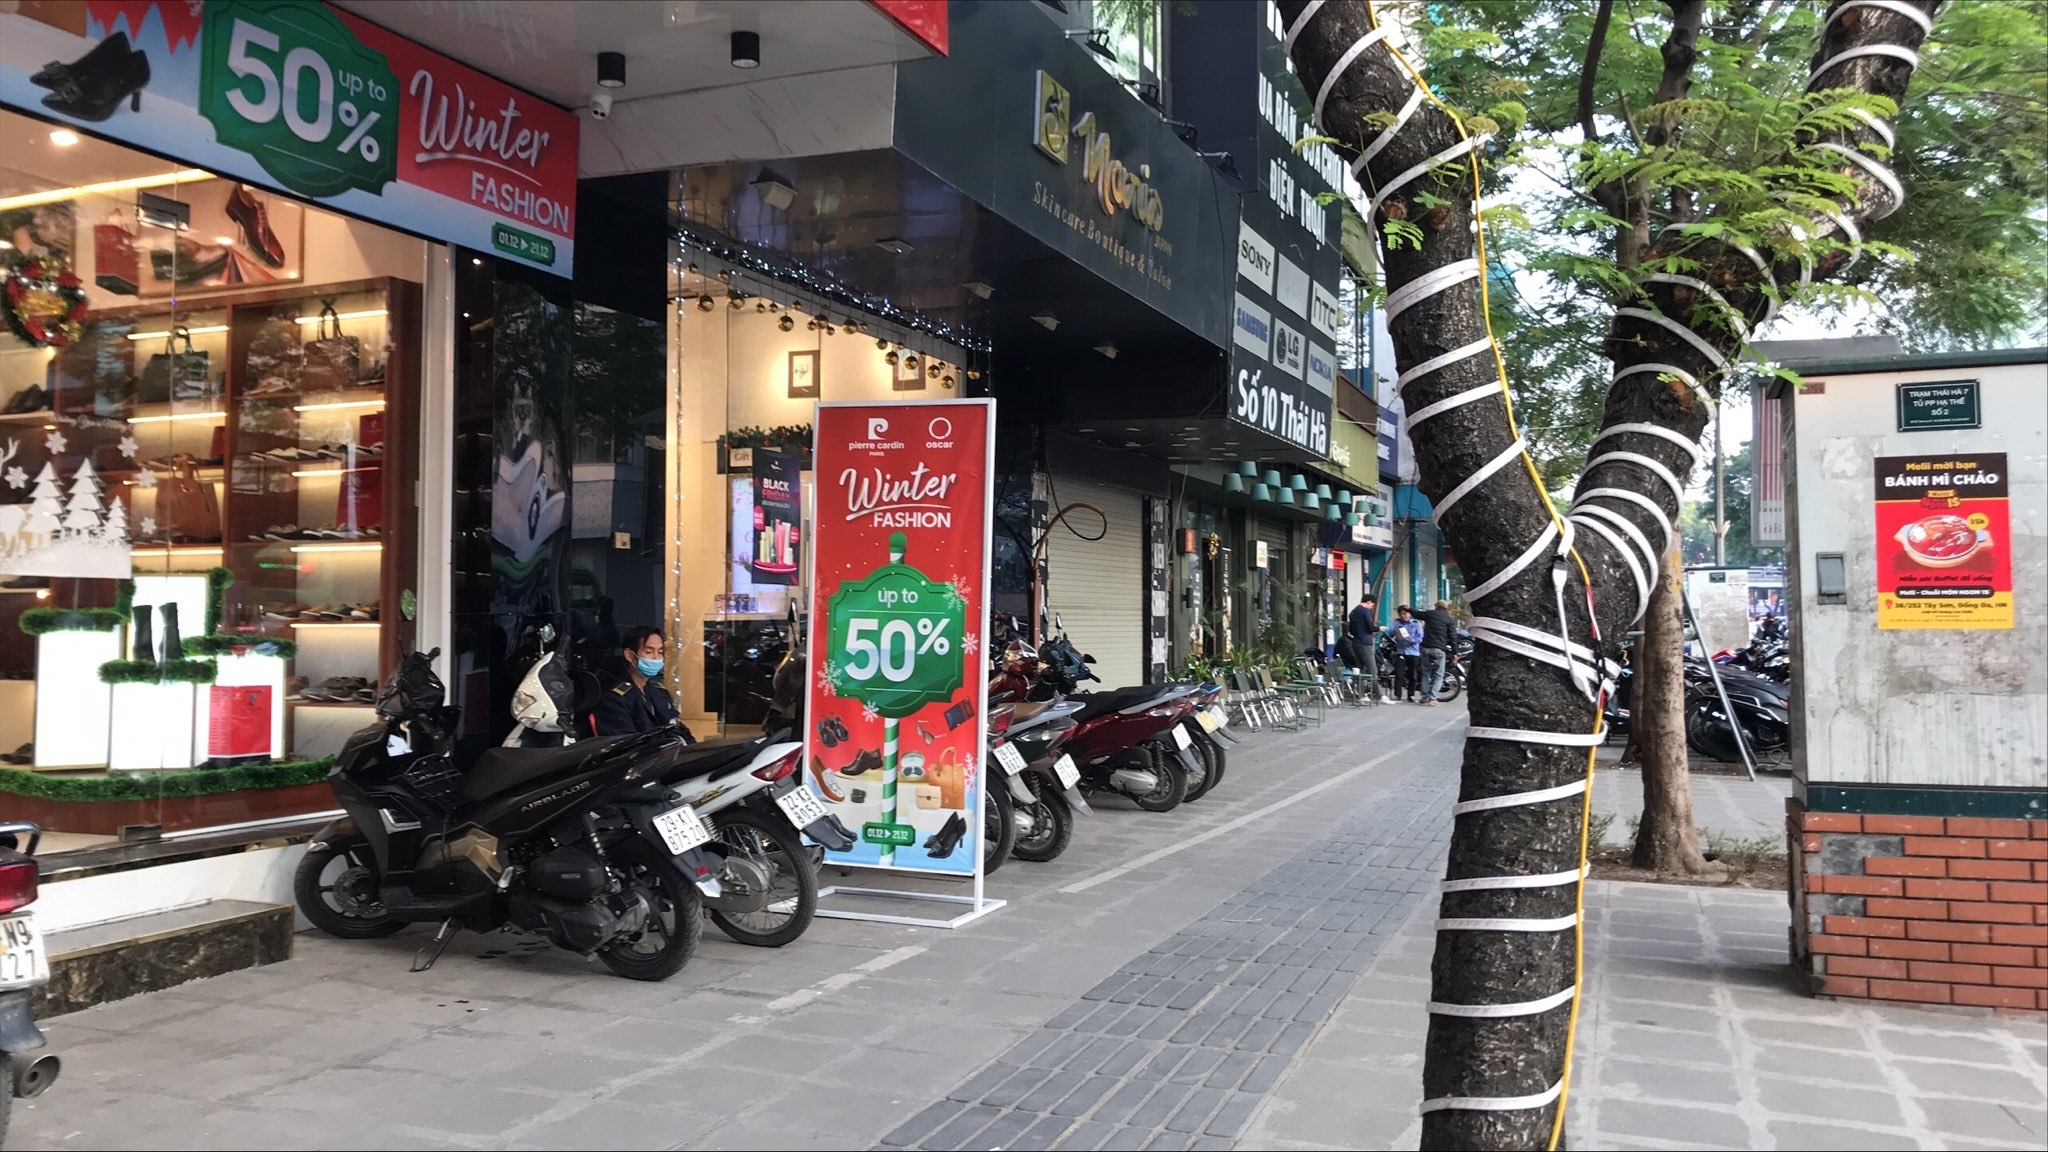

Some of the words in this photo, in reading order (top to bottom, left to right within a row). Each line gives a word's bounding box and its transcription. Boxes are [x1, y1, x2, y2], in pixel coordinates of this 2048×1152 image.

[225, 18, 382, 162] 50%
[338, 70, 363, 97] up
[367, 79, 387, 102] to
[409, 69, 550, 168] Winter
[471, 171, 569, 233] FASHION
[1034, 182, 1086, 234] Skincare
[1087, 219, 1136, 265] Boutique
[1137, 254, 1146, 274] &
[1240, 239, 1272, 277] SONY
[1236, 306, 1269, 343] SAMSUNG
[1287, 331, 1300, 358] LG
[1909, 390, 1931, 399] TRẠM
[1932, 388, 1950, 397] THÁI
[1950, 387, 1962, 395] HÀ
[1237, 368, 1262, 424] Số
[1261, 384, 1278, 431] 10
[1280, 391, 1310, 447] Thái
[1309, 407, 1327, 454] Hà
[1931, 407, 1943, 416] SỐ
[848, 440, 876, 451] pierre
[877, 440, 905, 450] cardin
[925, 441, 954, 449] oscar
[762, 477, 790, 492] BLACK
[838, 461, 957, 512] Winter
[1884, 473, 1930, 488] BÁNH
[1931, 472, 1950, 486] MÌ
[1952, 469, 2000, 485] CHẢO
[873, 512, 952, 529] FASHION
[878, 587, 898, 608] up
[900, 587, 919, 605] to
[844, 617, 951, 683] 50%
